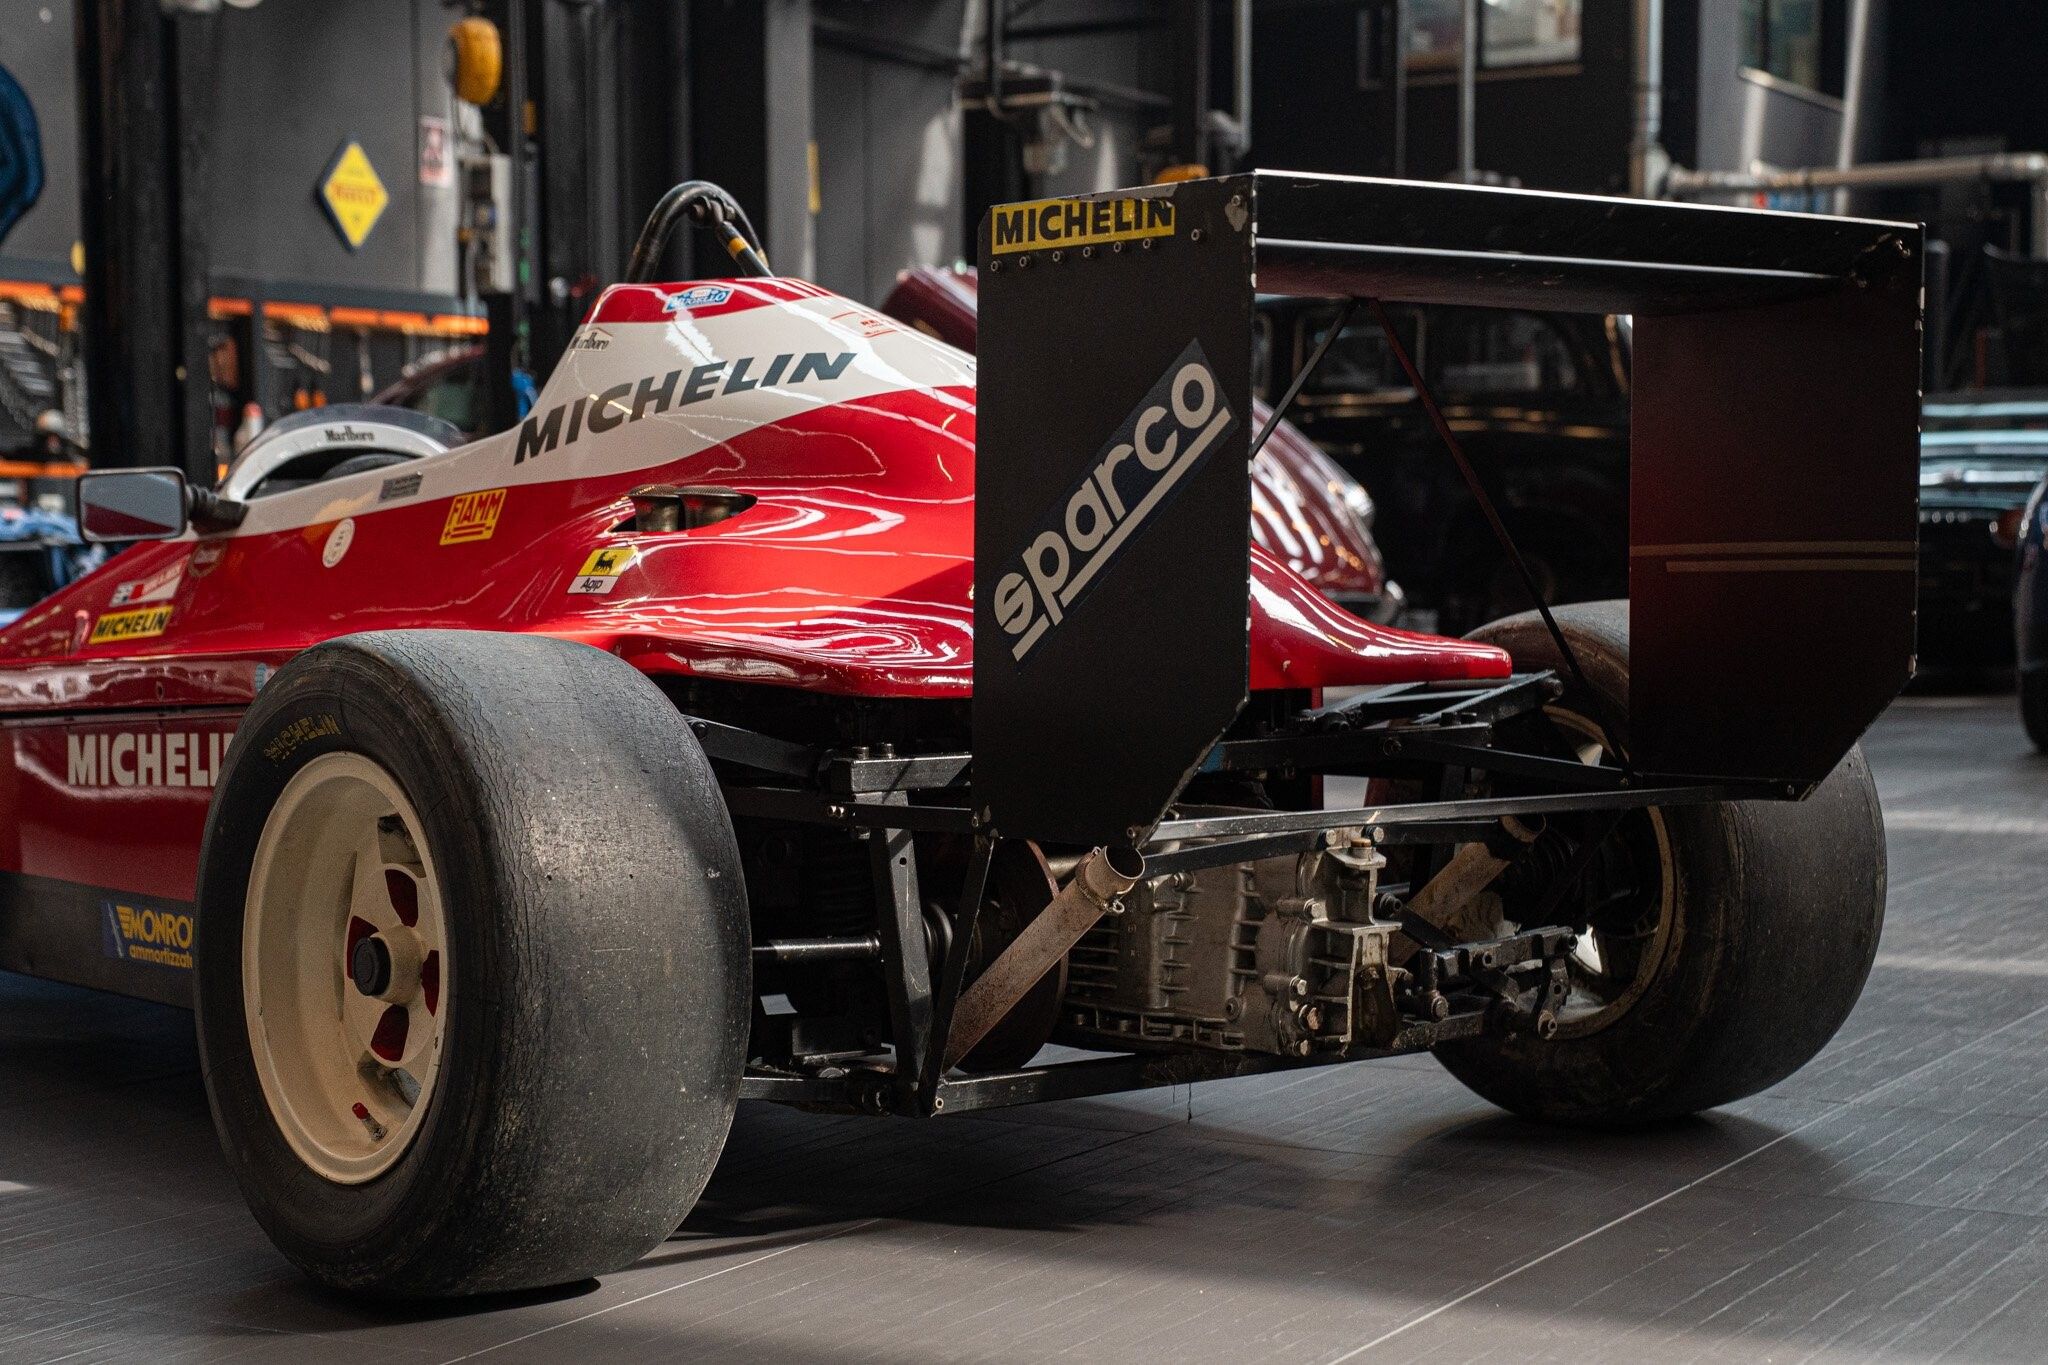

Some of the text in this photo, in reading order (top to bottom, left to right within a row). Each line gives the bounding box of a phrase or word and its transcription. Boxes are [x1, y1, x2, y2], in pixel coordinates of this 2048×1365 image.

[996, 199, 1172, 246] MICHELIN
[514, 352, 857, 466] MICHELIN
[325, 425, 375, 441] Marlboro
[451, 492, 503, 526] FIAMM
[994, 363, 1216, 635] sparco
[580, 577, 604, 592] Agip
[96, 611, 168, 637] MICHELIN
[116, 905, 194, 949] MONRO
